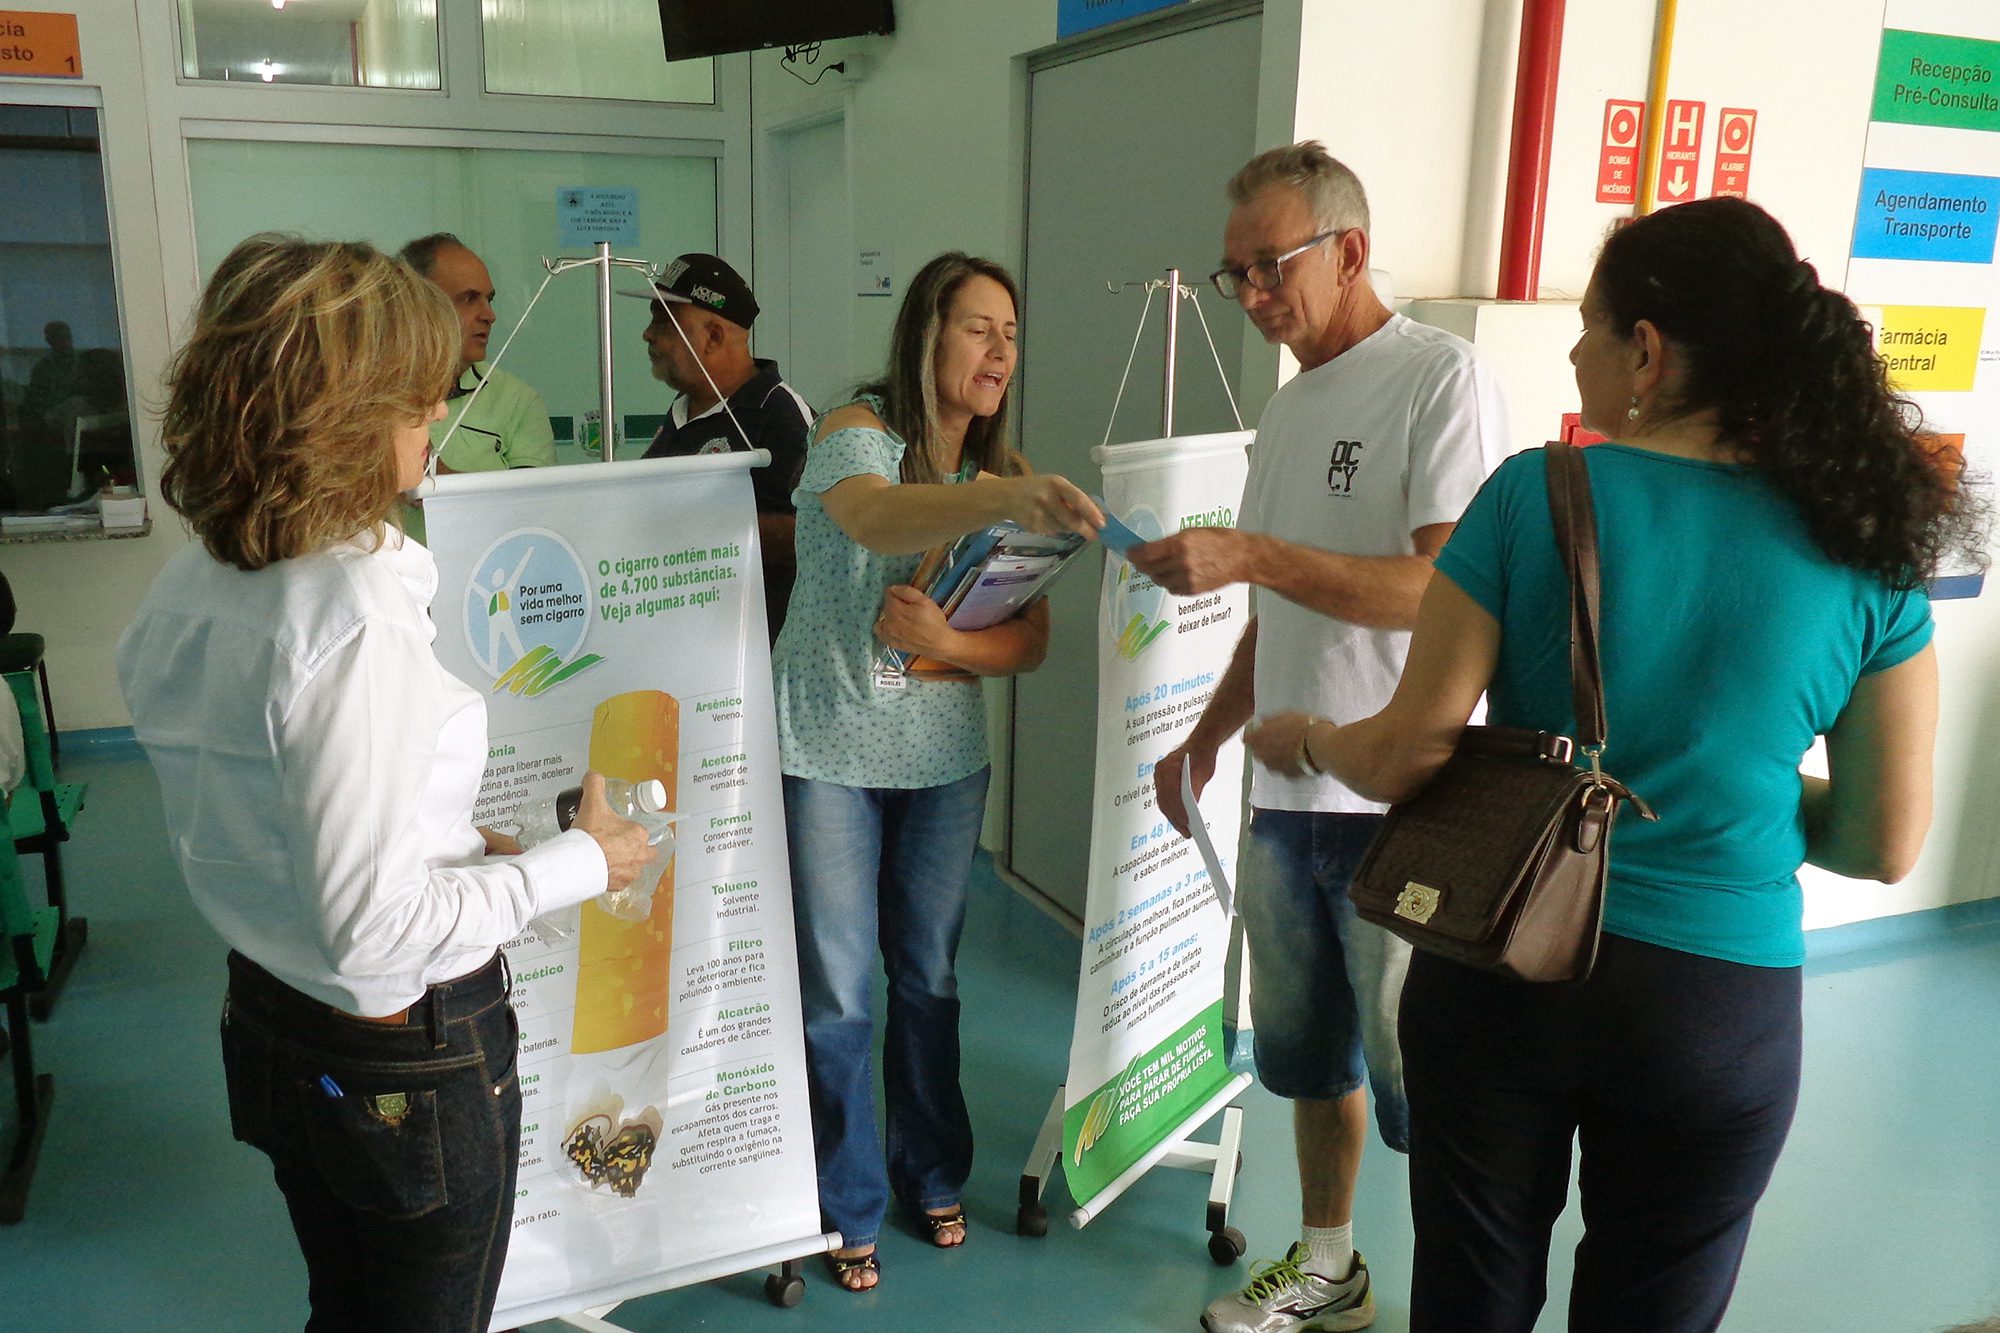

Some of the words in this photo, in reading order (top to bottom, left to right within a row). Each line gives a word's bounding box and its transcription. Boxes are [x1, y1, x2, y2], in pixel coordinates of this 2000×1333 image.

[65, 56, 75, 72] 1
[1910, 58, 1991, 86] Recepção
[1894, 84, 1998, 111] Pré-Consulta
[1671, 106, 1698, 146] H
[1609, 155, 1630, 165] BOMBA
[1666, 152, 1696, 161] HIDRANTE
[1721, 163, 1745, 172] ALARME
[1614, 171, 1622, 179] DE
[1602, 183, 1631, 194] INCÊNDIO
[1875, 190, 1987, 213] Agendamento
[1885, 218, 1971, 242] Transporte
[598, 560, 610, 576] O
[615, 557, 658, 577] cigarro
[663, 548, 707, 567] contém
[711, 543, 740, 559] mais
[520, 585, 538, 597] Por
[540, 583, 562, 593] uma
[600, 582, 616, 599] de
[622, 575, 657, 595] 4.700
[662, 566, 737, 588] substâncias.
[520, 599, 544, 611] vida
[546, 593, 582, 607] melhor
[600, 604, 631, 623] Veja
[636, 595, 684, 618] algumas
[689, 587, 720, 608] aqui:
[1178, 598, 1212, 616] benefícios
[1214, 594, 1221, 604] de
[521, 613, 543, 625] sem
[546, 609, 584, 624] cigarro
[1178, 619, 1200, 634] deixar
[1202, 615, 1209, 627] de
[1211, 607, 1231, 624] fumar?
[1125, 692, 1151, 712] Após
[1154, 684, 1167, 701] 20
[1172, 672, 1214, 695] minutos:
[696, 698, 742, 713] Arsênico
[1133, 716, 1145, 728] sua
[1147, 705, 1175, 725] pressão
[712, 712, 743, 722] Veneno.
[1127, 730, 1150, 746] devem
[1152, 721, 1173, 736] voltar
[497, 765, 514, 777] para
[517, 760, 542, 771] liberar
[544, 754, 562, 766] mais
[701, 753, 747, 768] Acetona
[514, 773, 540, 784] assim,
[542, 766, 574, 779] acelerar
[693, 768, 734, 784] Removedor
[737, 765, 747, 774] de
[710, 778, 748, 791] esmaltes.
[475, 788, 530, 807] dependência.
[1123, 786, 1140, 804] nível
[710, 811, 752, 828] Formol
[703, 827, 753, 842] Conservante
[1131, 834, 1147, 851] Em
[1151, 823, 1163, 838] 48
[706, 846, 715, 854] de
[718, 839, 753, 851] cadáver.
[1120, 847, 1160, 874] capacidade
[1140, 861, 1160, 878] sabor
[712, 881, 758, 895] Tolueno
[722, 893, 759, 906] Solvente
[1088, 920, 1114, 944] Após
[1117, 910, 1125, 925] 2
[1128, 885, 1172, 920] semanas
[1184, 873, 1190, 886] 3
[1105, 921, 1141, 951] circulação
[1172, 899, 1184, 911] fica
[1185, 888, 1200, 903] mais
[729, 939, 763, 951] Filtro
[1090, 948, 1123, 975] caminhar
[1135, 926, 1158, 948] função
[1159, 908, 1191, 934] pulmonar
[515, 964, 564, 984] Acético
[687, 965, 704, 976] Leva
[707, 959, 720, 969] 100
[723, 955, 742, 966] anos
[745, 952, 764, 964] para
[1111, 970, 1136, 995] Após
[1158, 947, 1170, 964] 15
[1172, 932, 1198, 956] anos:
[687, 979, 695, 987] se
[698, 968, 738, 984] deteriorar
[749, 964, 765, 972] fica
[1111, 996, 1128, 1013] risco
[1140, 970, 1166, 993] derrame
[1182, 946, 1202, 965] infarto
[680, 986, 712, 1002] poluindo
[722, 976, 765, 989] ambiente.
[1101, 1014, 1121, 1034] reduz
[1132, 994, 1148, 1012] nível
[1149, 987, 1160, 1000] das
[1162, 968, 1188, 994] pessoas
[1189, 960, 1201, 974] que
[718, 1003, 770, 1021] Alcatrão
[1127, 1010, 1146, 1031] nunca
[706, 1028, 719, 1037] um
[721, 1023, 735, 1033] dos
[738, 1016, 771, 1030] grandes
[524, 1037, 559, 1053] baterias.
[681, 1038, 725, 1055] causadores
[728, 1034, 738, 1042] de
[741, 1028, 772, 1040] câncer.
[1120, 1073, 1141, 1096] VOCÊ
[1142, 1061, 1159, 1080] TEM
[1160, 1050, 1175, 1068] MIL
[1176, 1025, 1207, 1057] MOTIVOS
[717, 1062, 774, 1082] Monóxido
[1120, 1090, 1141, 1111] PARA
[1143, 1071, 1169, 1098] PARAR
[1171, 1061, 1181, 1075] DE
[1182, 1040, 1206, 1066] FUMAR.
[706, 1090, 719, 1101] de
[724, 1079, 776, 1096] Carbono
[1120, 1104, 1141, 1126] FAÇA
[1143, 1091, 1160, 1109] SUA
[1162, 1068, 1191, 1097] PRÓPRIA
[1192, 1049, 1214, 1072] LISTA.
[705, 1103, 720, 1113] Gás
[723, 1095, 761, 1110] presente
[764, 1092, 778, 1100] nos
[672, 1113, 730, 1135] escapamentos
[732, 1109, 747, 1119] dos
[750, 1104, 778, 1115] carros.
[698, 1127, 721, 1138] Afeta
[724, 1122, 747, 1133] quem
[750, 1116, 772, 1126] traga
[680, 1143, 704, 1156] quem
[707, 1133, 736, 1147] respira
[747, 1125, 781, 1139] fumaça,
[672, 1150, 724, 1169] substituindo
[735, 1139, 770, 1154] oxigênio
[772, 1136, 783, 1144] na
[700, 1158, 736, 1174] corrente
[514, 1215, 535, 1228] para
[538, 1208, 560, 1221] rato.
